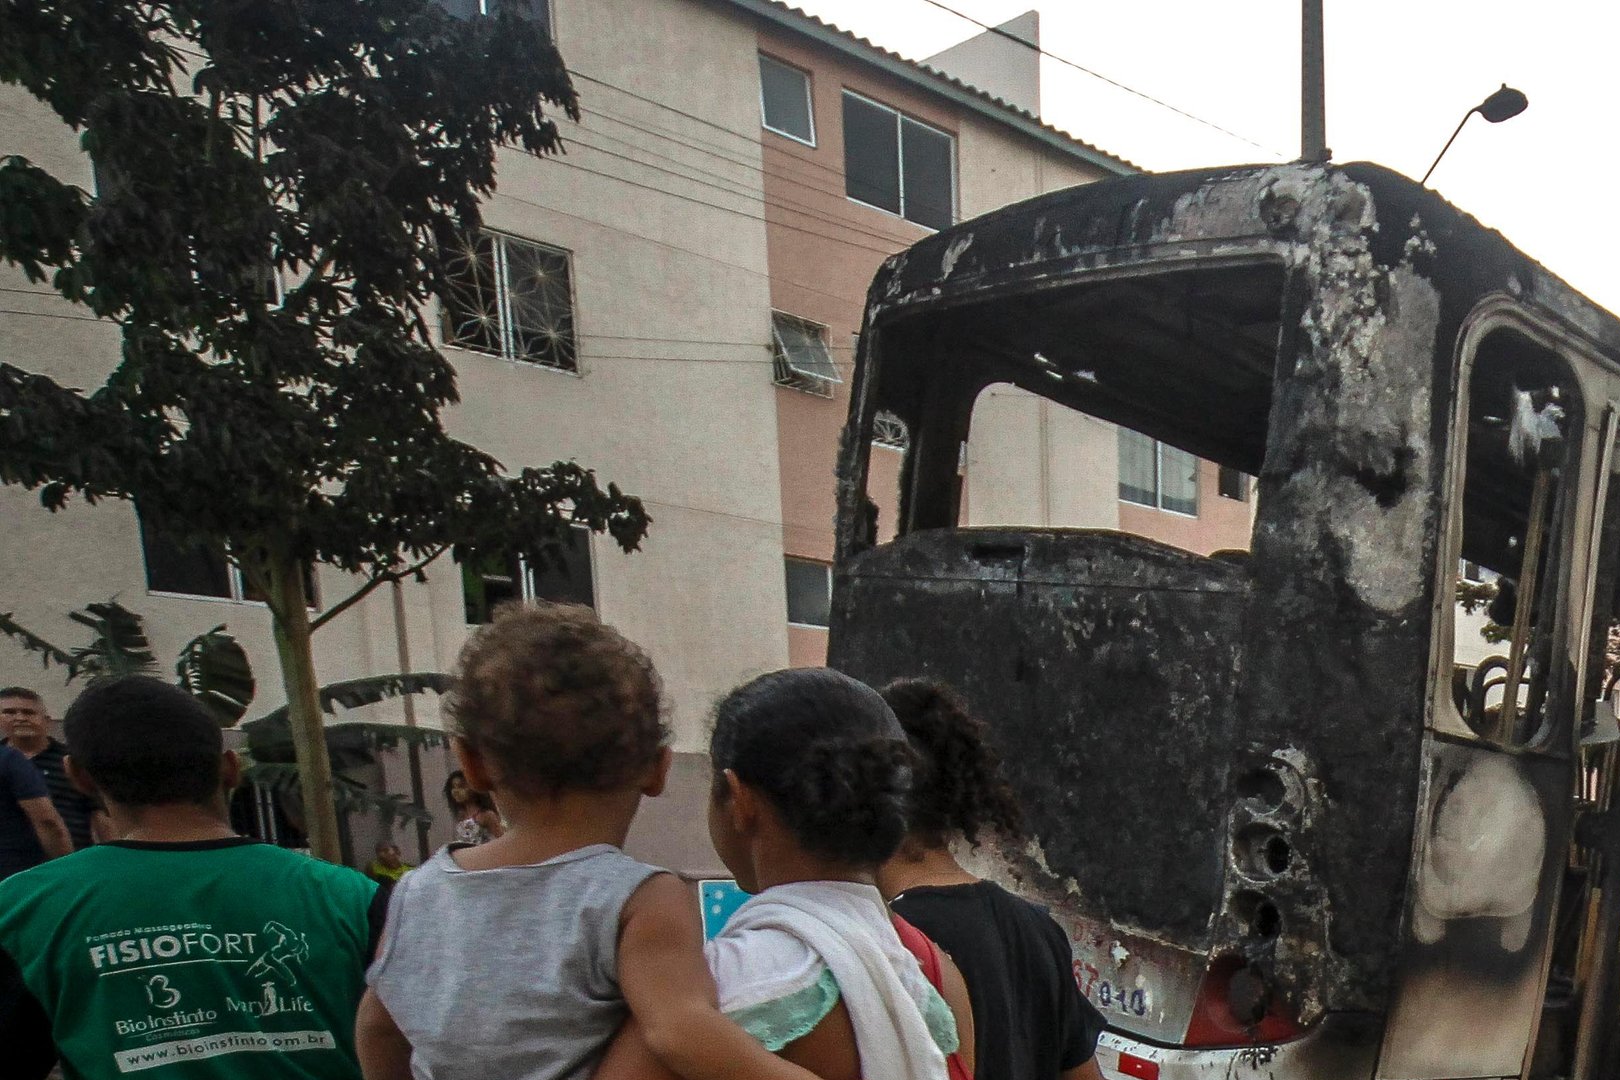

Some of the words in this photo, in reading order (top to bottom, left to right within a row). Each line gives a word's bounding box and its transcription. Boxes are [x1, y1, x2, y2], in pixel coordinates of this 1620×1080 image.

[89, 933, 256, 969] FISIOFORT
[279, 995, 314, 1012] Life
[115, 1008, 217, 1035] BioInstinto
